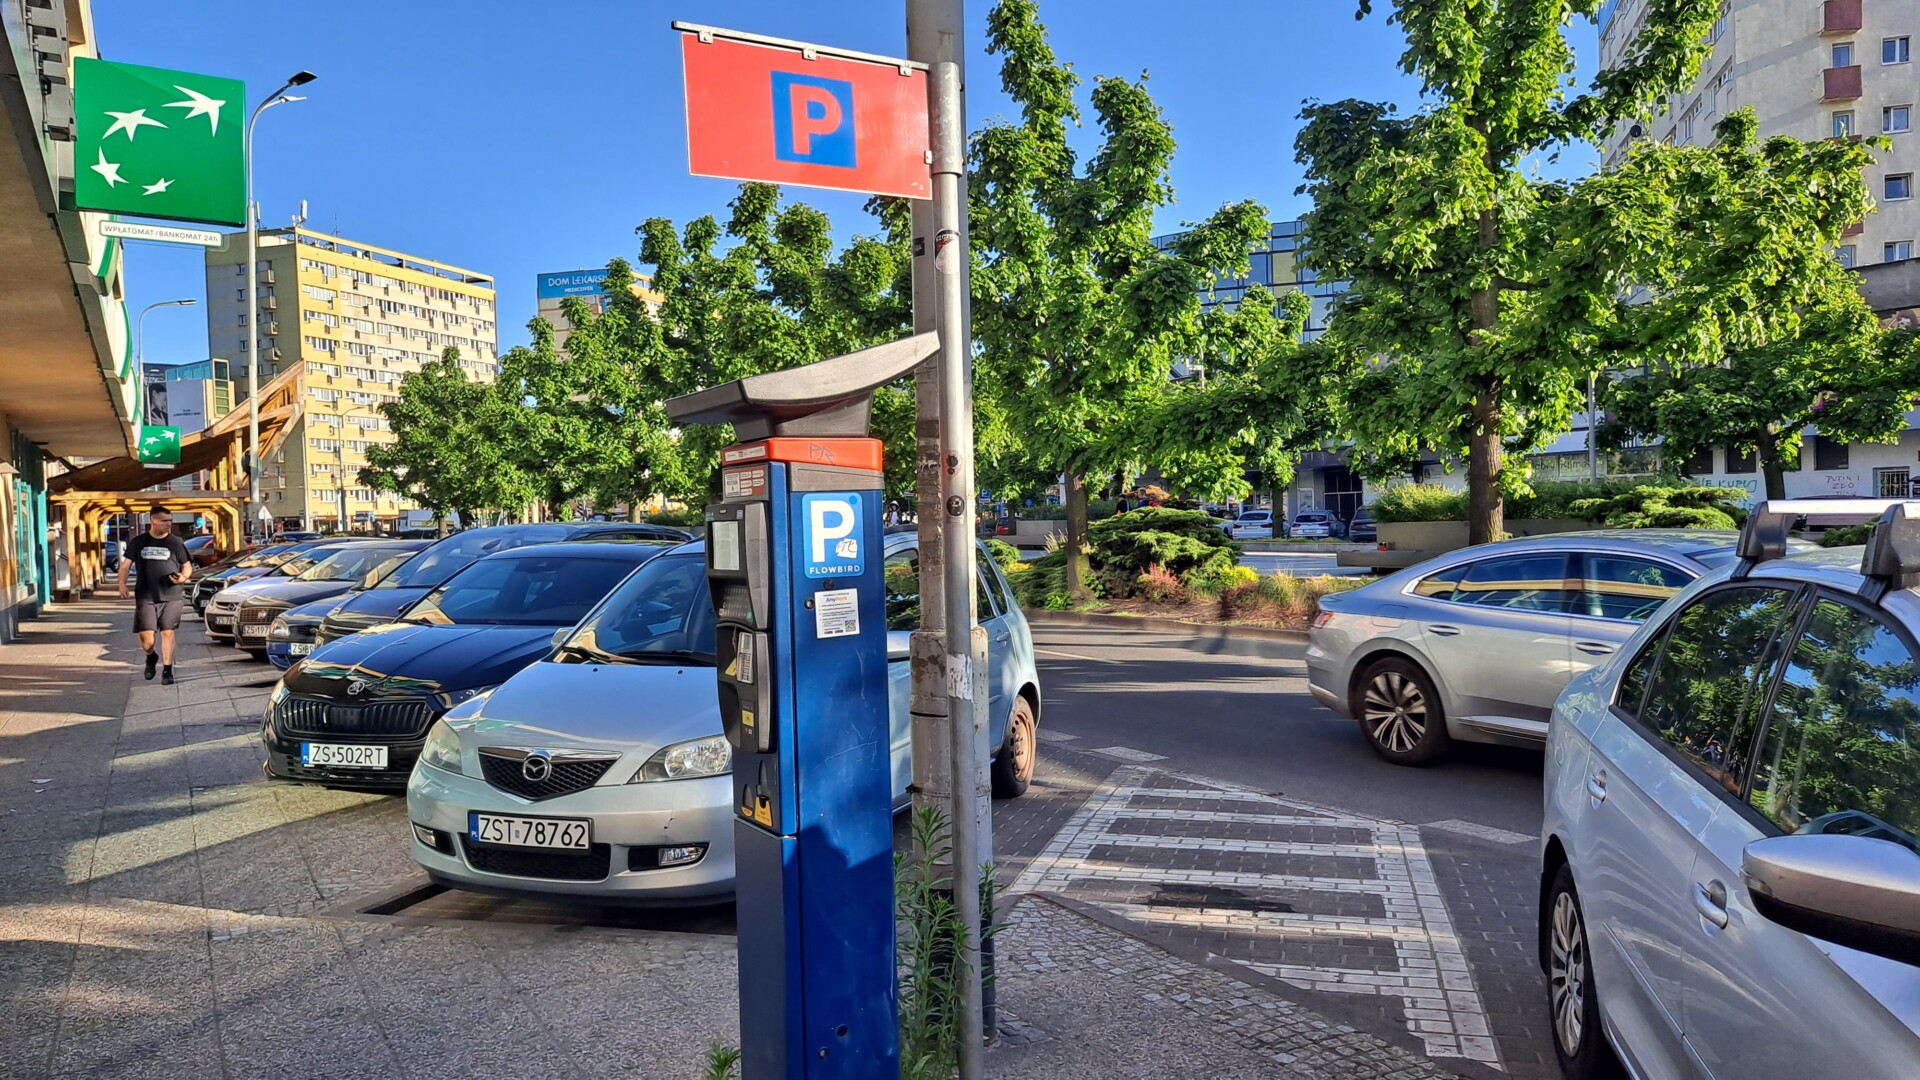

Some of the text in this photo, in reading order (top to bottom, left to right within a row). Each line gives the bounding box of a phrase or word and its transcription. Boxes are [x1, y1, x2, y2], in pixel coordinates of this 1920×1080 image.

[790, 83, 842, 154] P
[204, 234, 219, 242] 24h
[548, 274, 608, 287] DOM LEKARSK
[811, 500, 855, 563] P
[809, 565, 861, 575] FLOWBIRD
[292, 644, 302, 653] ZS
[312, 745, 331, 763] ZS
[336, 747, 384, 765] 502RT
[480, 817, 515, 843] ZST
[522, 821, 586, 847] 78762
